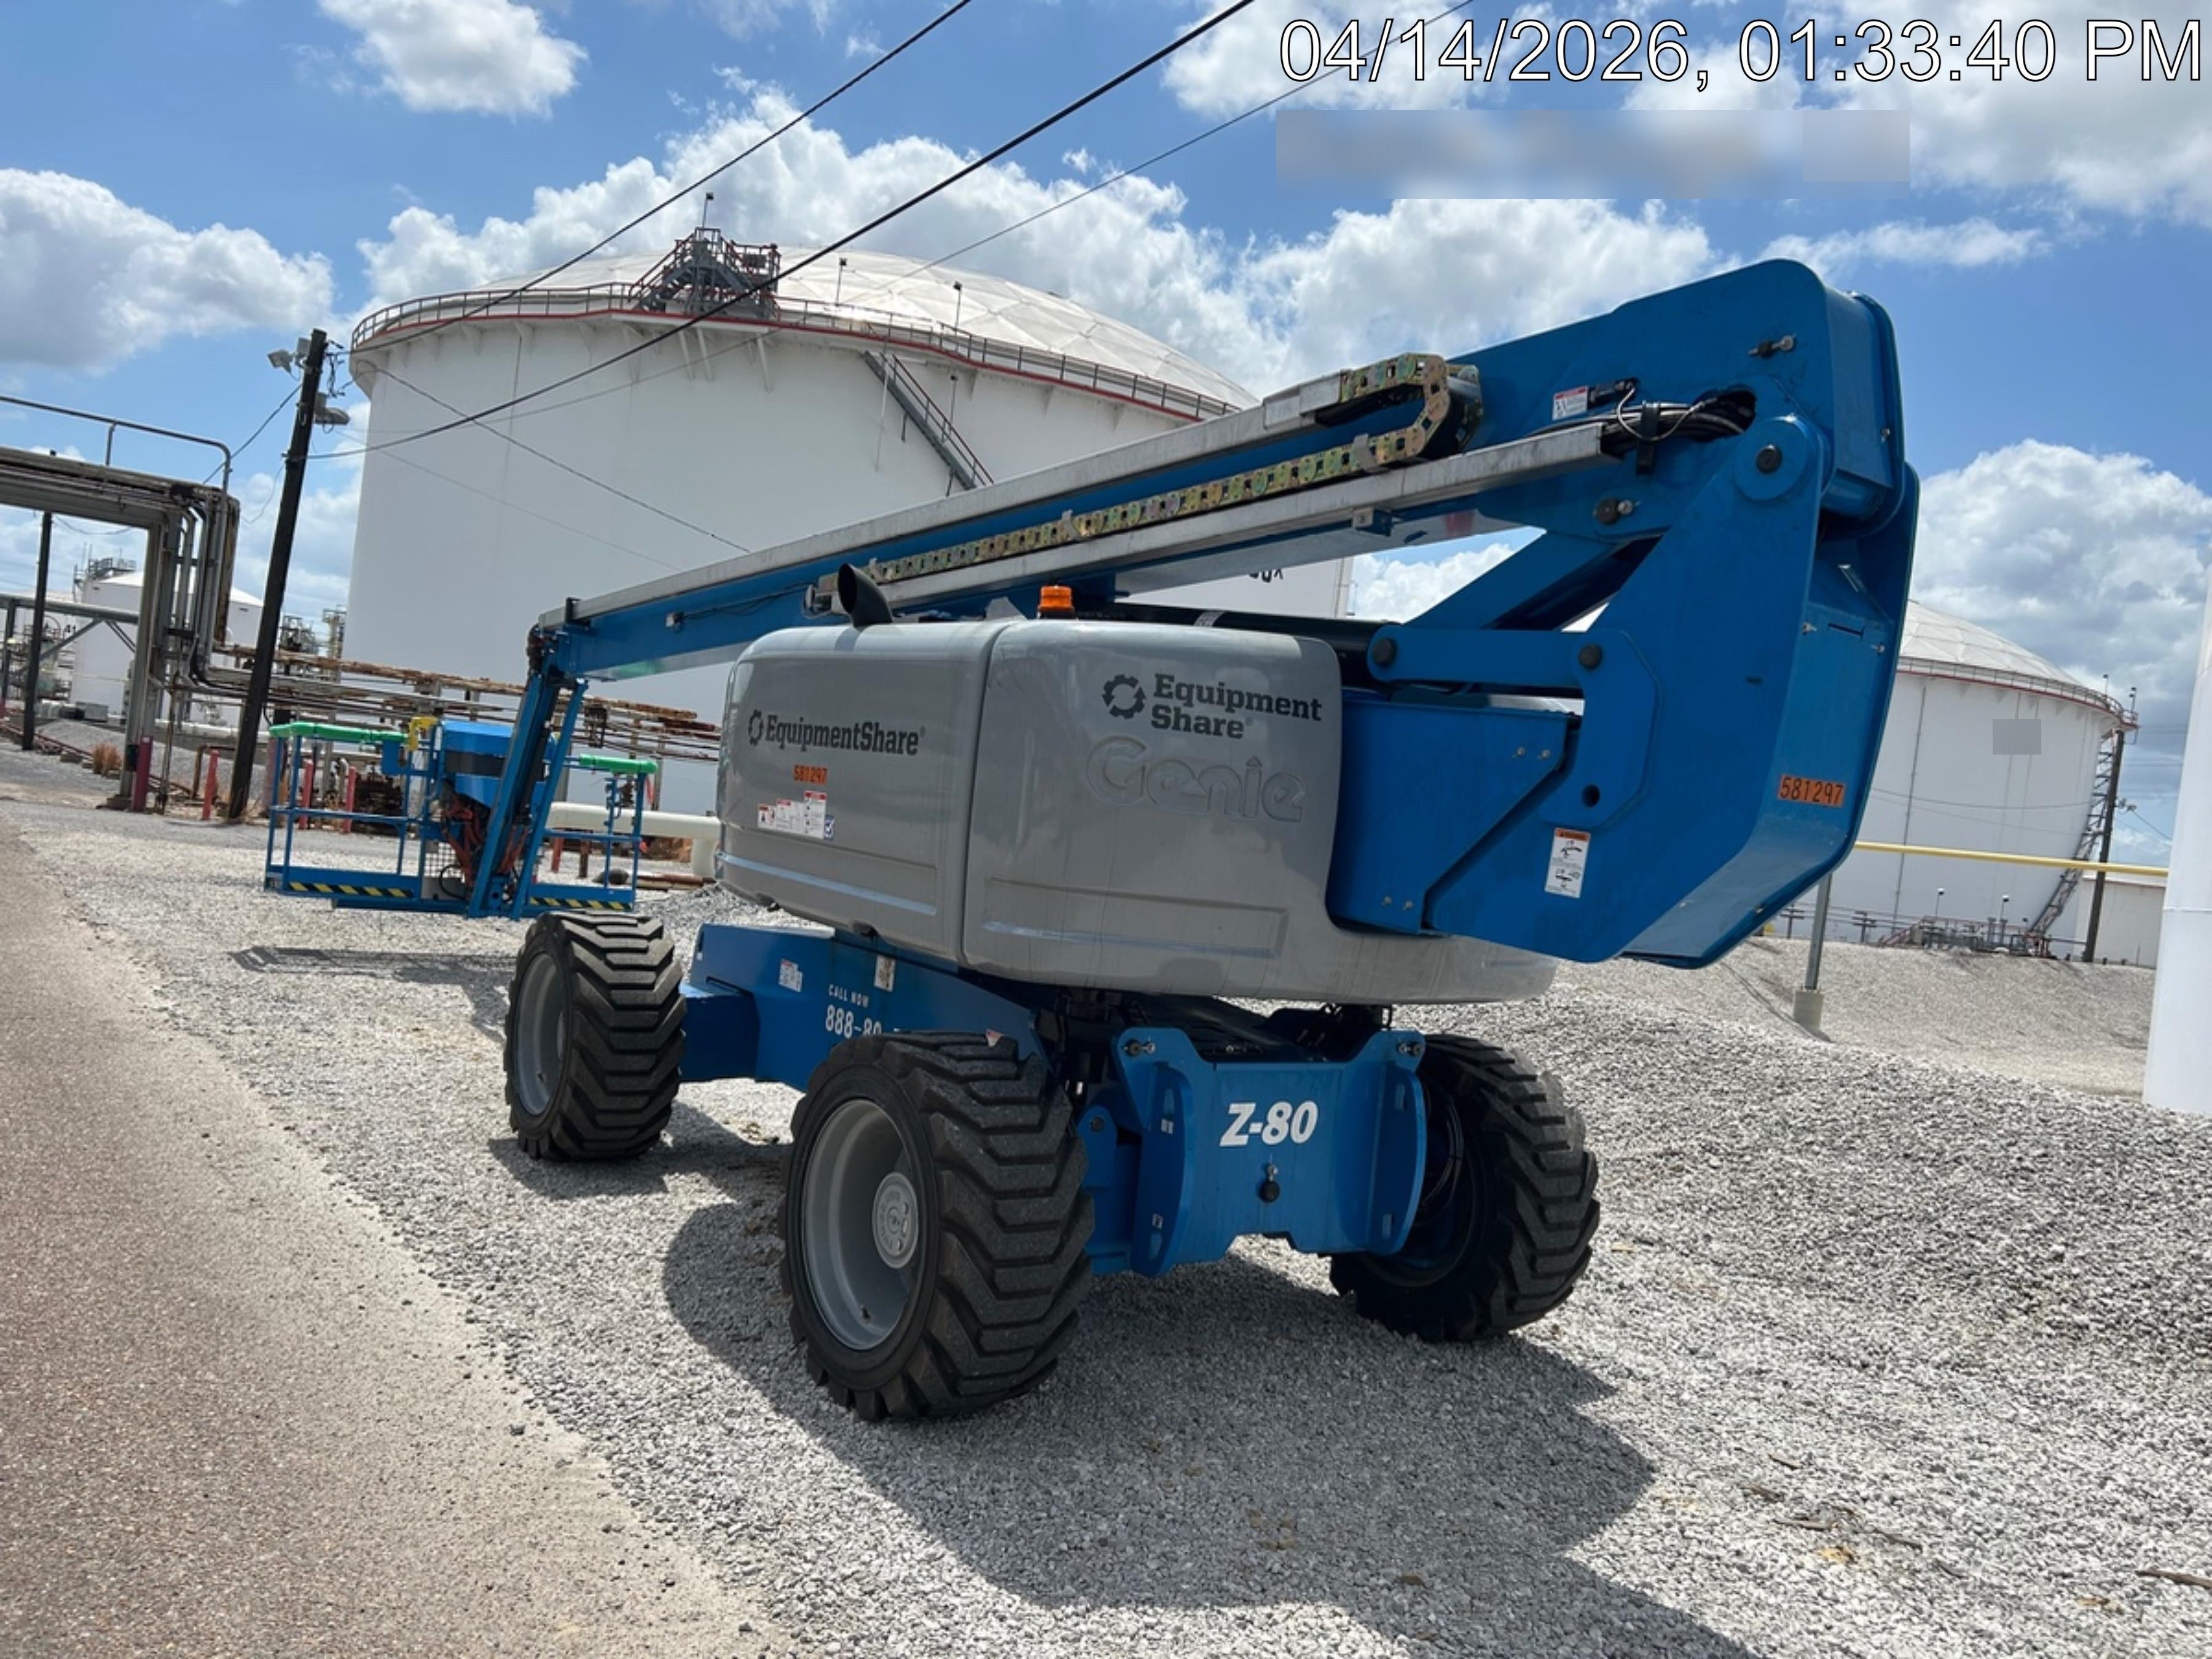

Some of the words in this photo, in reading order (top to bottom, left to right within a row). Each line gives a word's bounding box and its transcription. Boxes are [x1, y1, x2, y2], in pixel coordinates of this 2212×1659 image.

[1153, 673, 1323, 721] Equipment
[765, 715, 919, 756] EquipmentShare
[1151, 704, 1244, 739] Share
[1086, 735, 1306, 822] Genie
[1780, 775, 1844, 805] 581297
[828, 984, 848, 1002] CALL
[851, 990, 869, 1008] NOW
[826, 1003, 900, 1038] 888-80
[1220, 1100, 1319, 1147] Z-80
